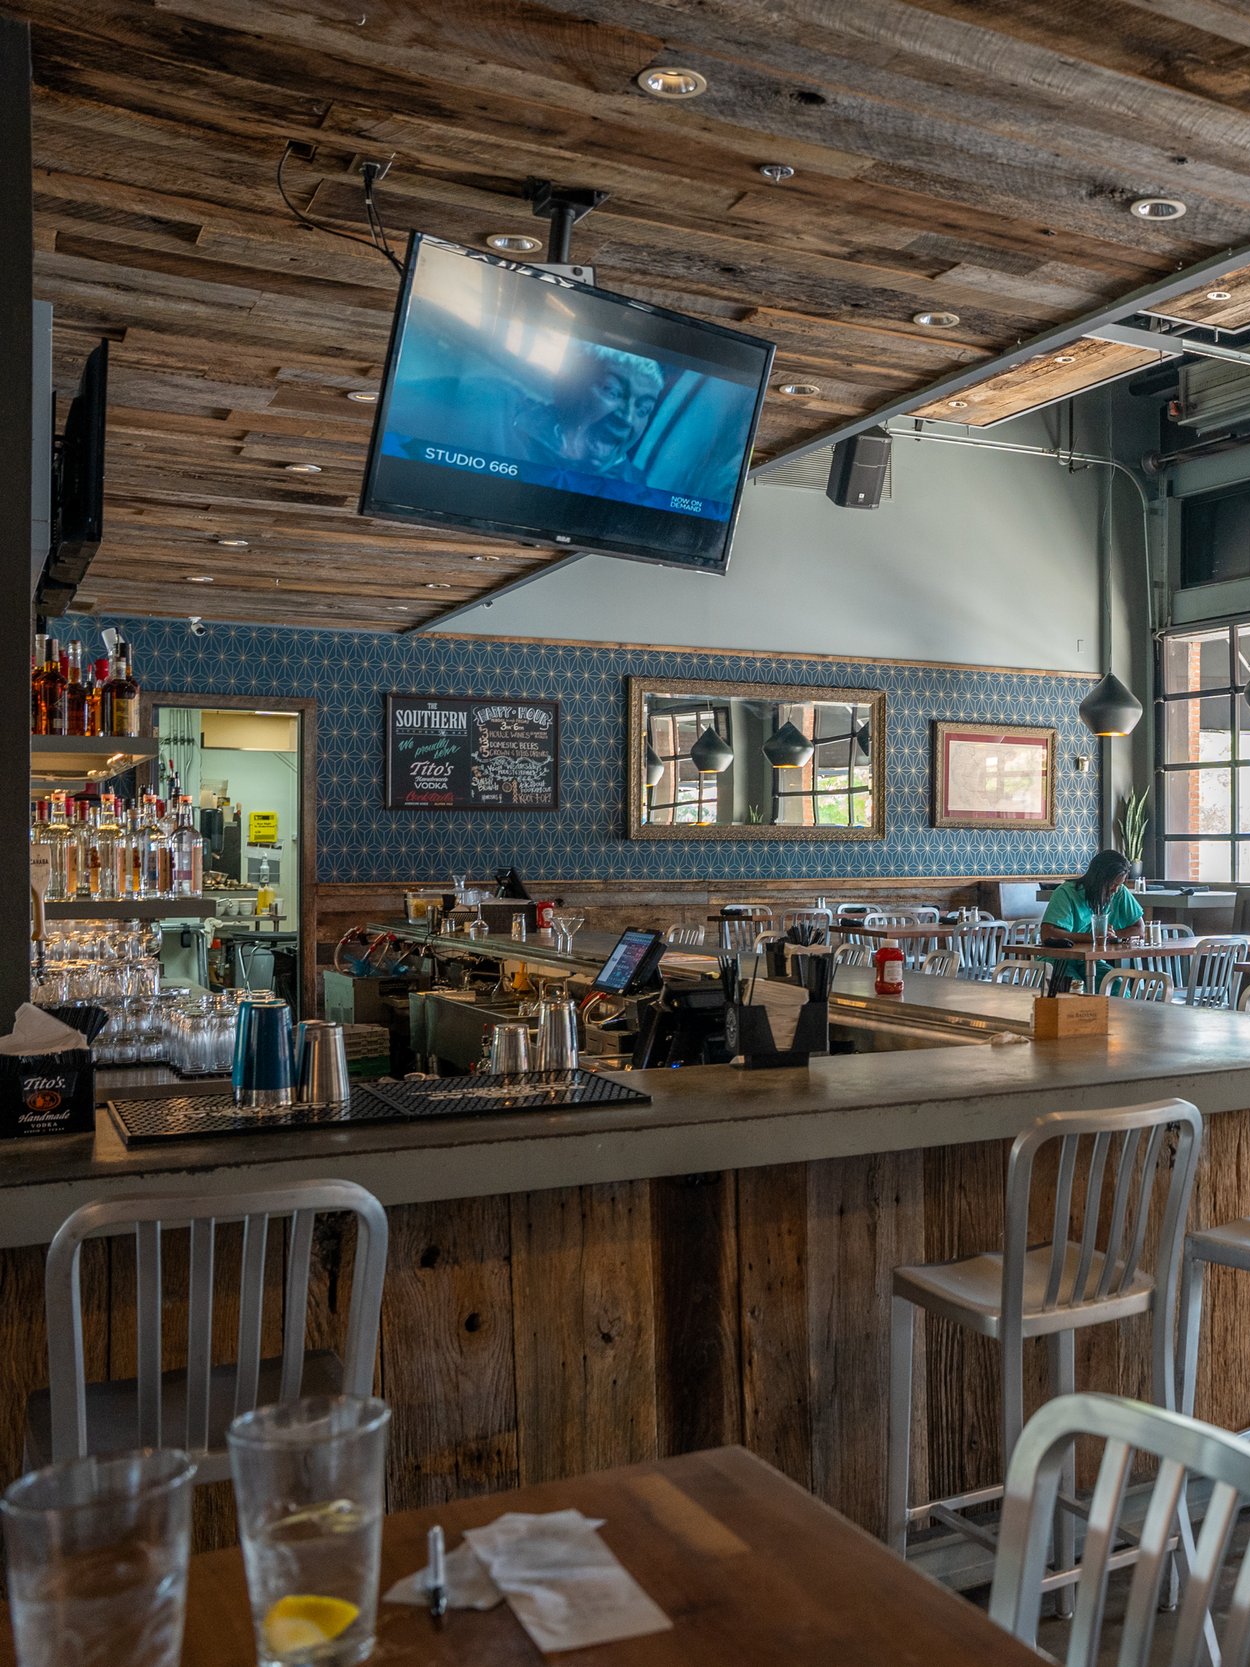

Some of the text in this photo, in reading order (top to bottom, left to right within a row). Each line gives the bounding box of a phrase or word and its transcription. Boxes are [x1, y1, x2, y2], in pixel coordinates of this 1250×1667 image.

[425, 447, 519, 476] STUDIO 666
[670, 502, 702, 513] DEMAND
[671, 496, 690, 505] NOW
[427, 702, 438, 710] THE
[395, 709, 468, 729] SOUTHERN
[477, 706, 550, 726] HAPPY HOUR
[410, 760, 454, 776] Tito's
[414, 782, 448, 790] VODKA
[18, 1109, 71, 1124] Handmade
